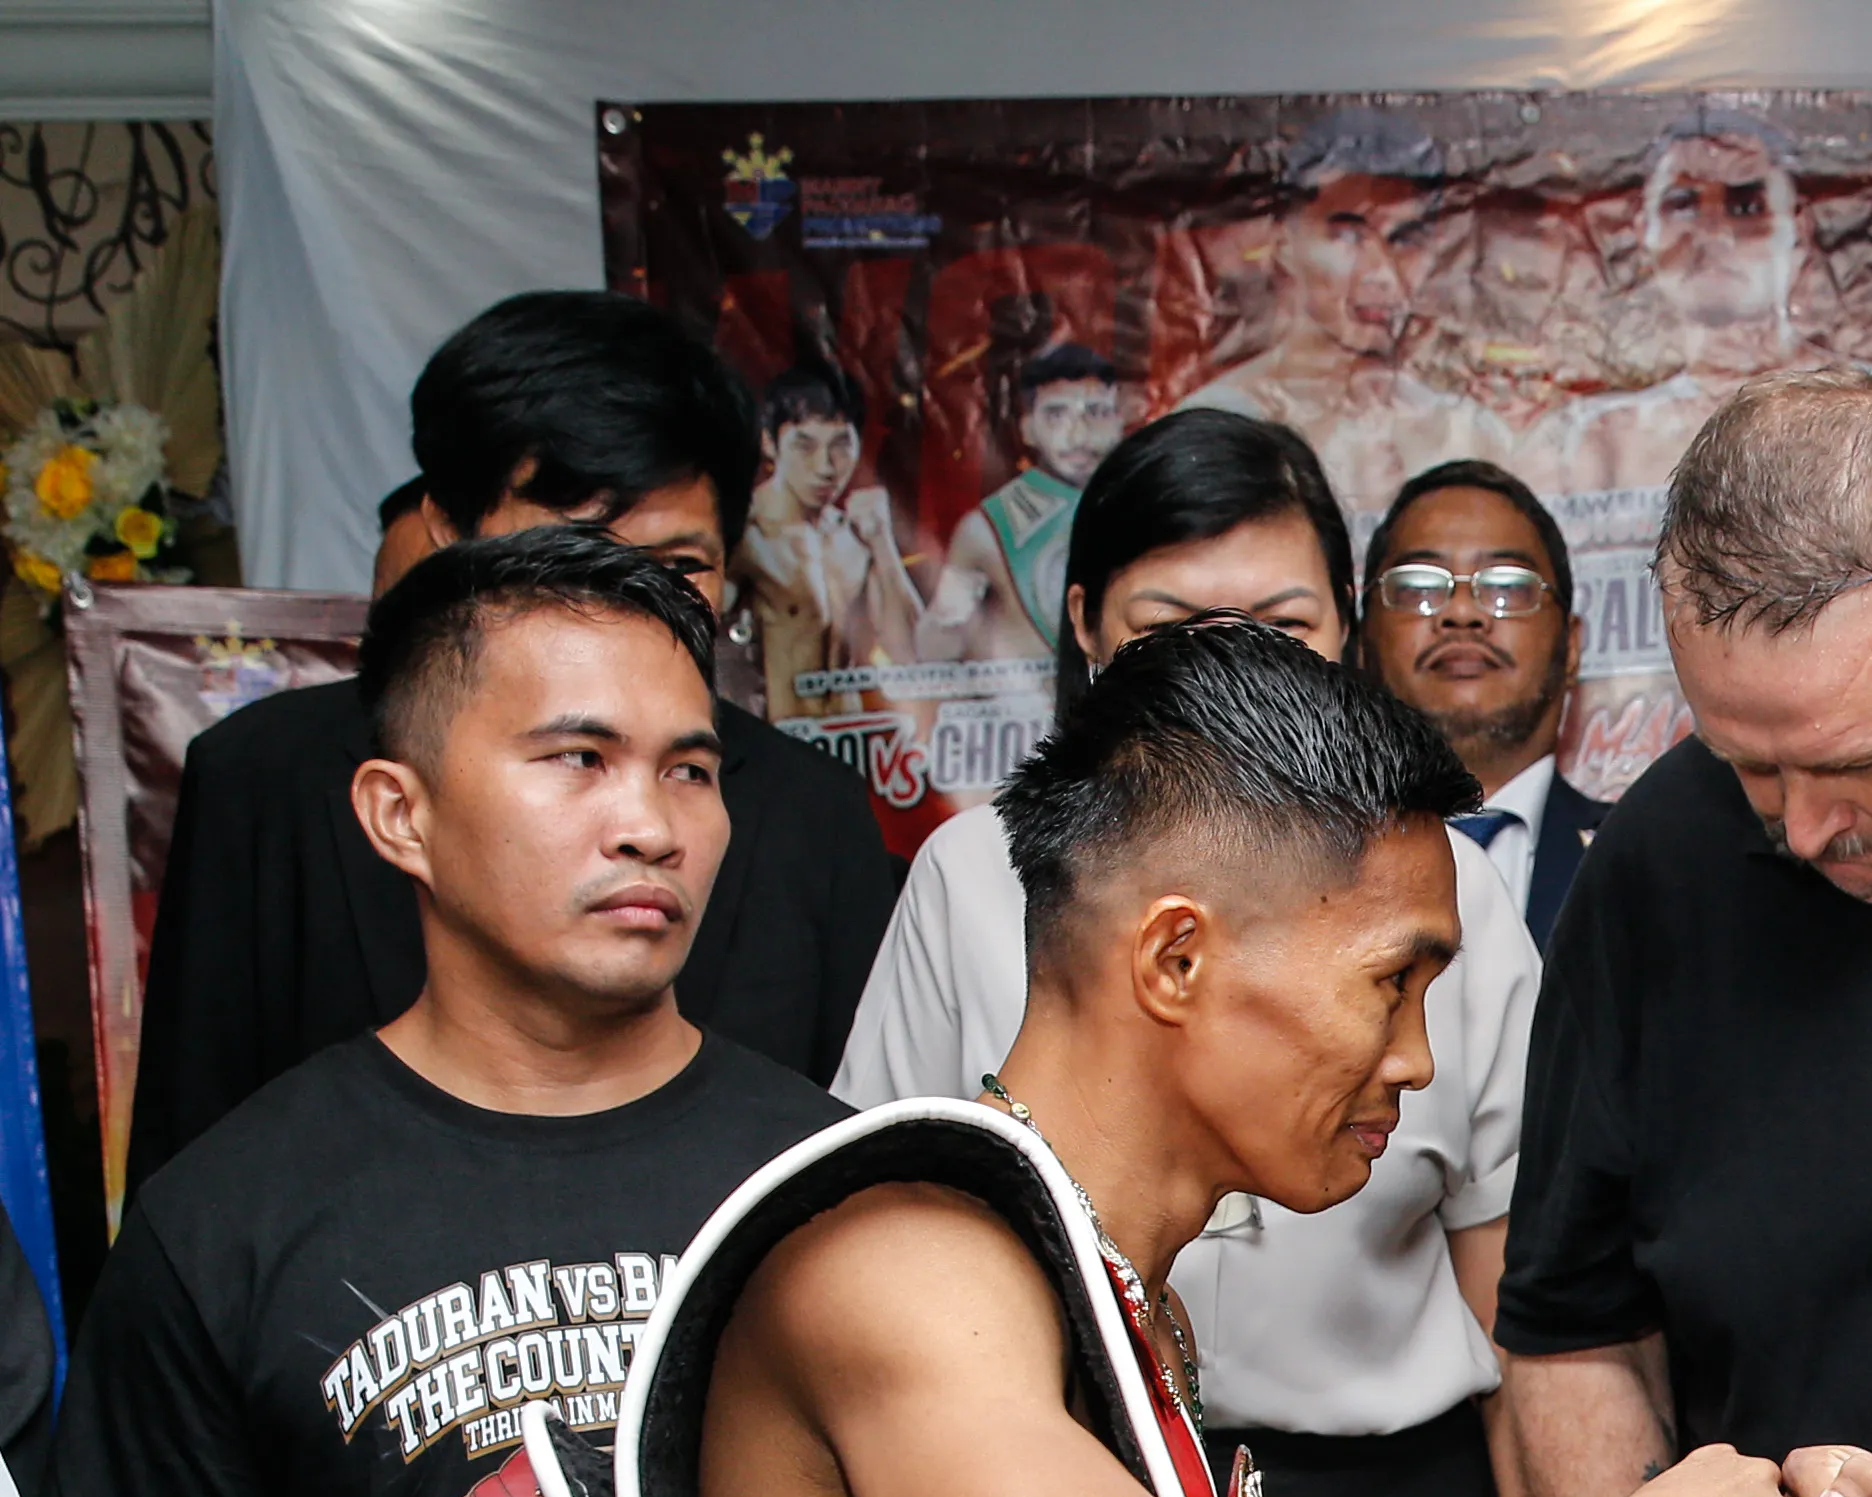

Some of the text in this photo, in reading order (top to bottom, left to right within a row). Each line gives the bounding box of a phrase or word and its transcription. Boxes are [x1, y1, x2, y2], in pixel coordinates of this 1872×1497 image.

[833, 671, 871, 687] PAN
[868, 728, 925, 801] VS
[323, 1261, 558, 1438] TADURAN
[555, 1264, 616, 1318] VS
[386, 1351, 487, 1458] THE
[566, 1394, 594, 1427] IN
